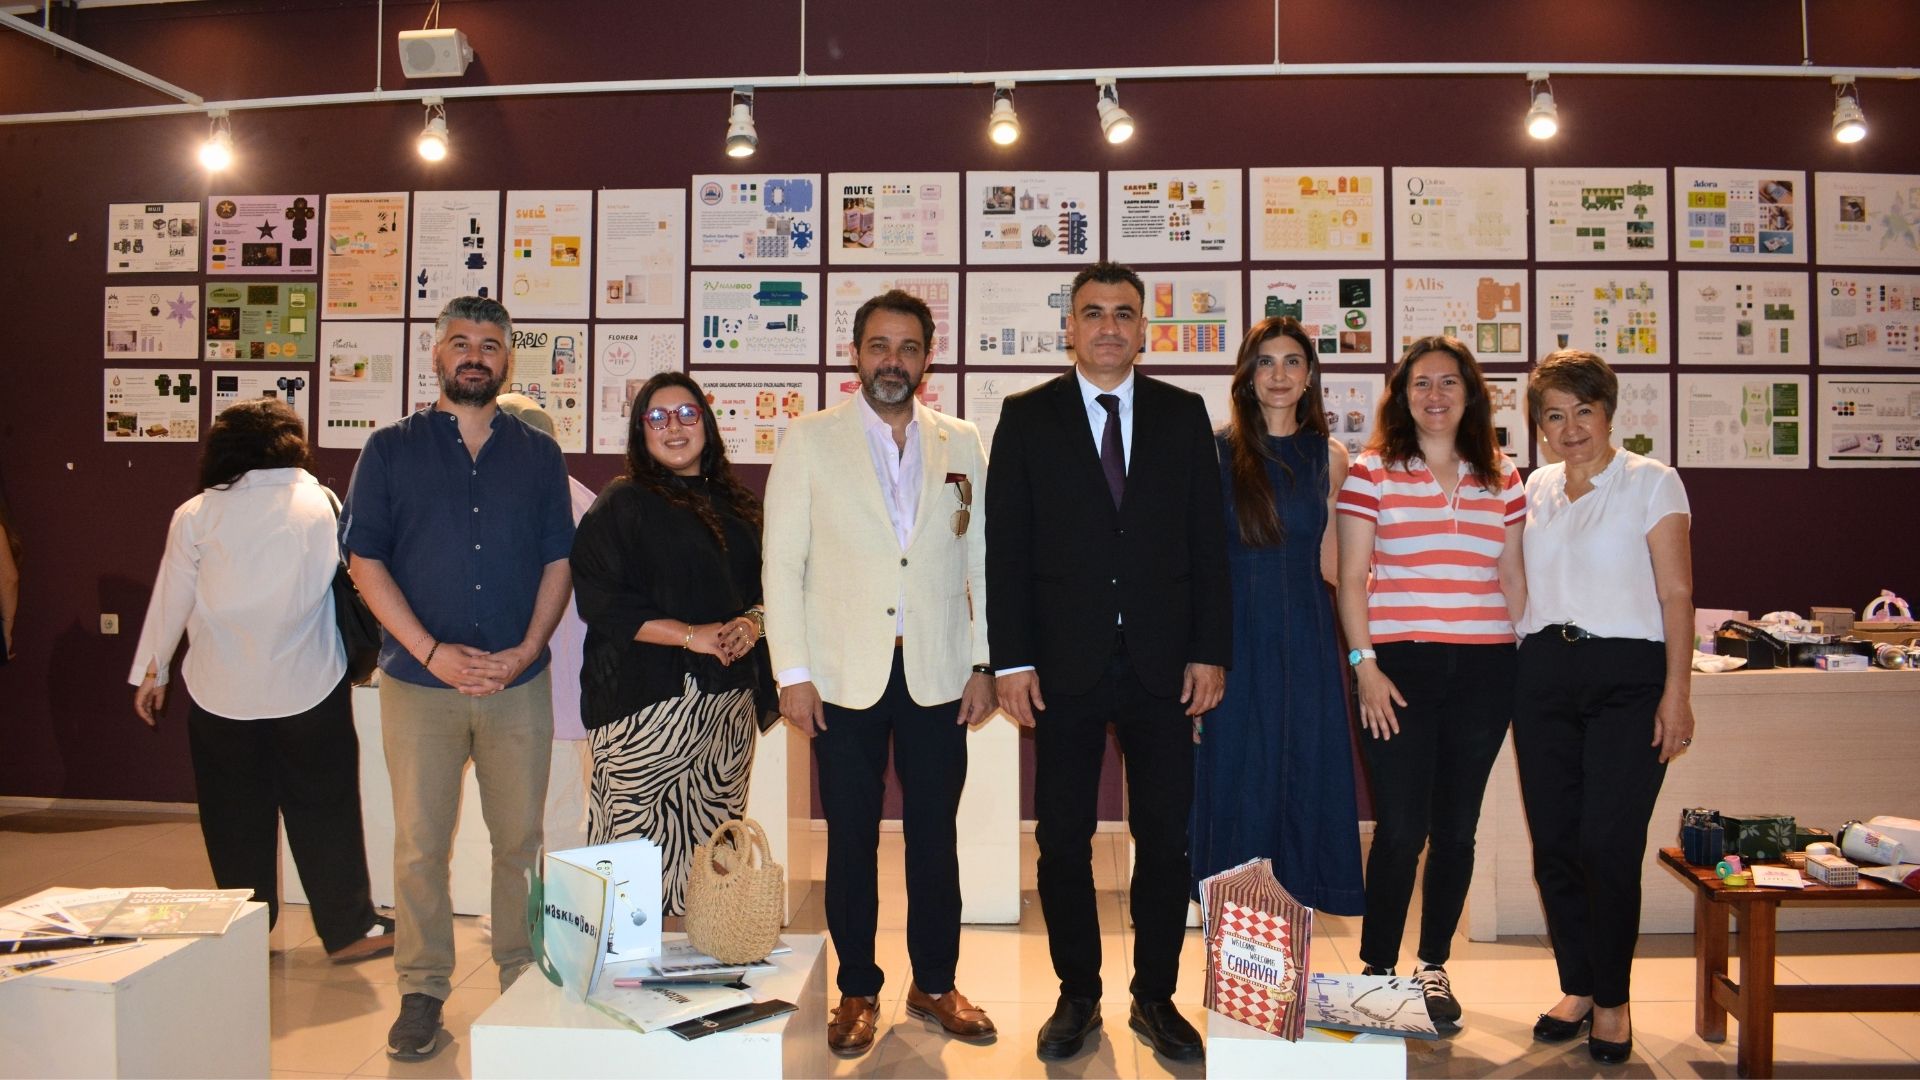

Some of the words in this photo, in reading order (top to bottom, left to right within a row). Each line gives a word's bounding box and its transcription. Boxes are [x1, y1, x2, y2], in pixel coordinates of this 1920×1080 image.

[843, 186, 873, 195] MUTE
[1415, 278, 1445, 291] Alis
[511, 331, 548, 349] PABLO
[1227, 954, 1281, 988] CARAVAL
